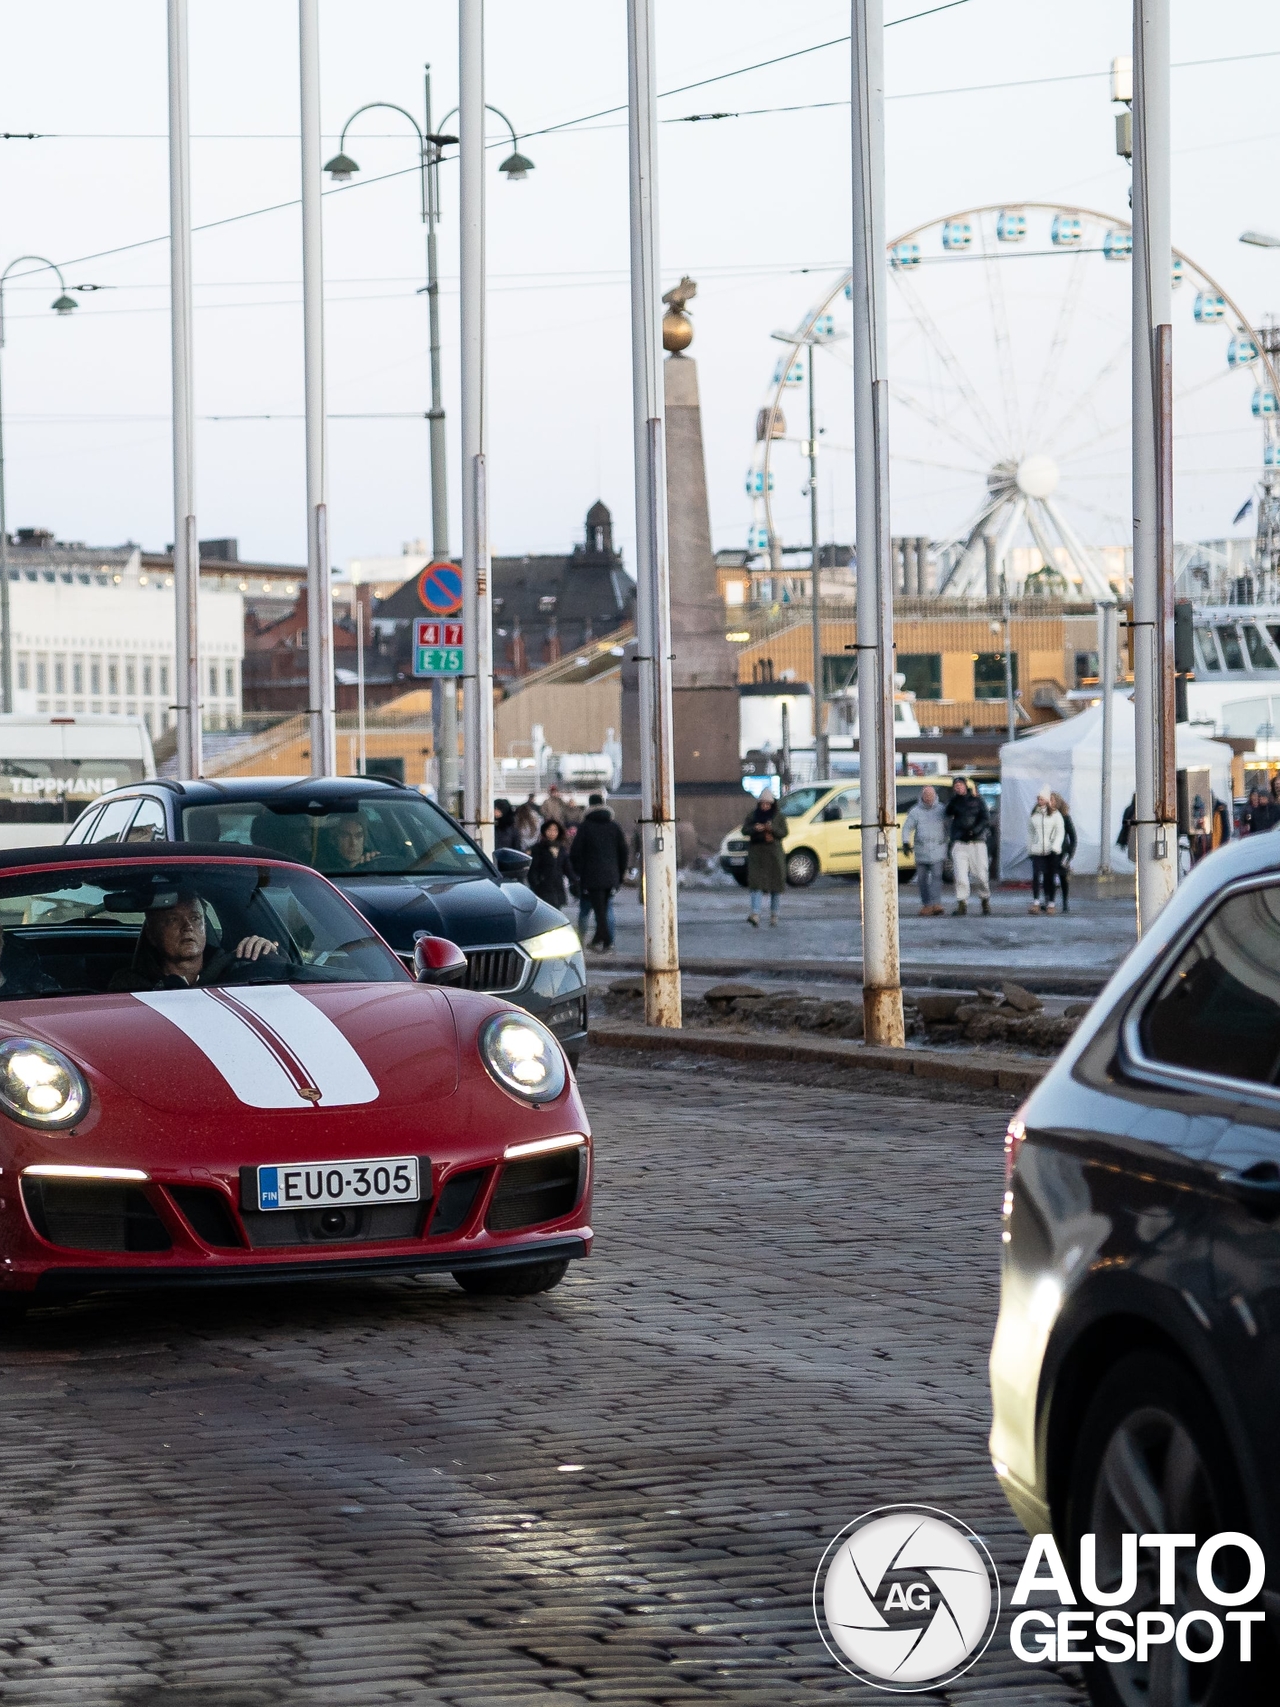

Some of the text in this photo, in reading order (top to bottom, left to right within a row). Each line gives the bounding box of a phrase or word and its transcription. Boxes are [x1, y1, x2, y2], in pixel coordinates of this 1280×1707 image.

[423, 625, 460, 643] 4 7
[423, 650, 460, 669] E 75
[284, 1165, 411, 1202] EUO-305
[262, 1191, 277, 1201] FIN
